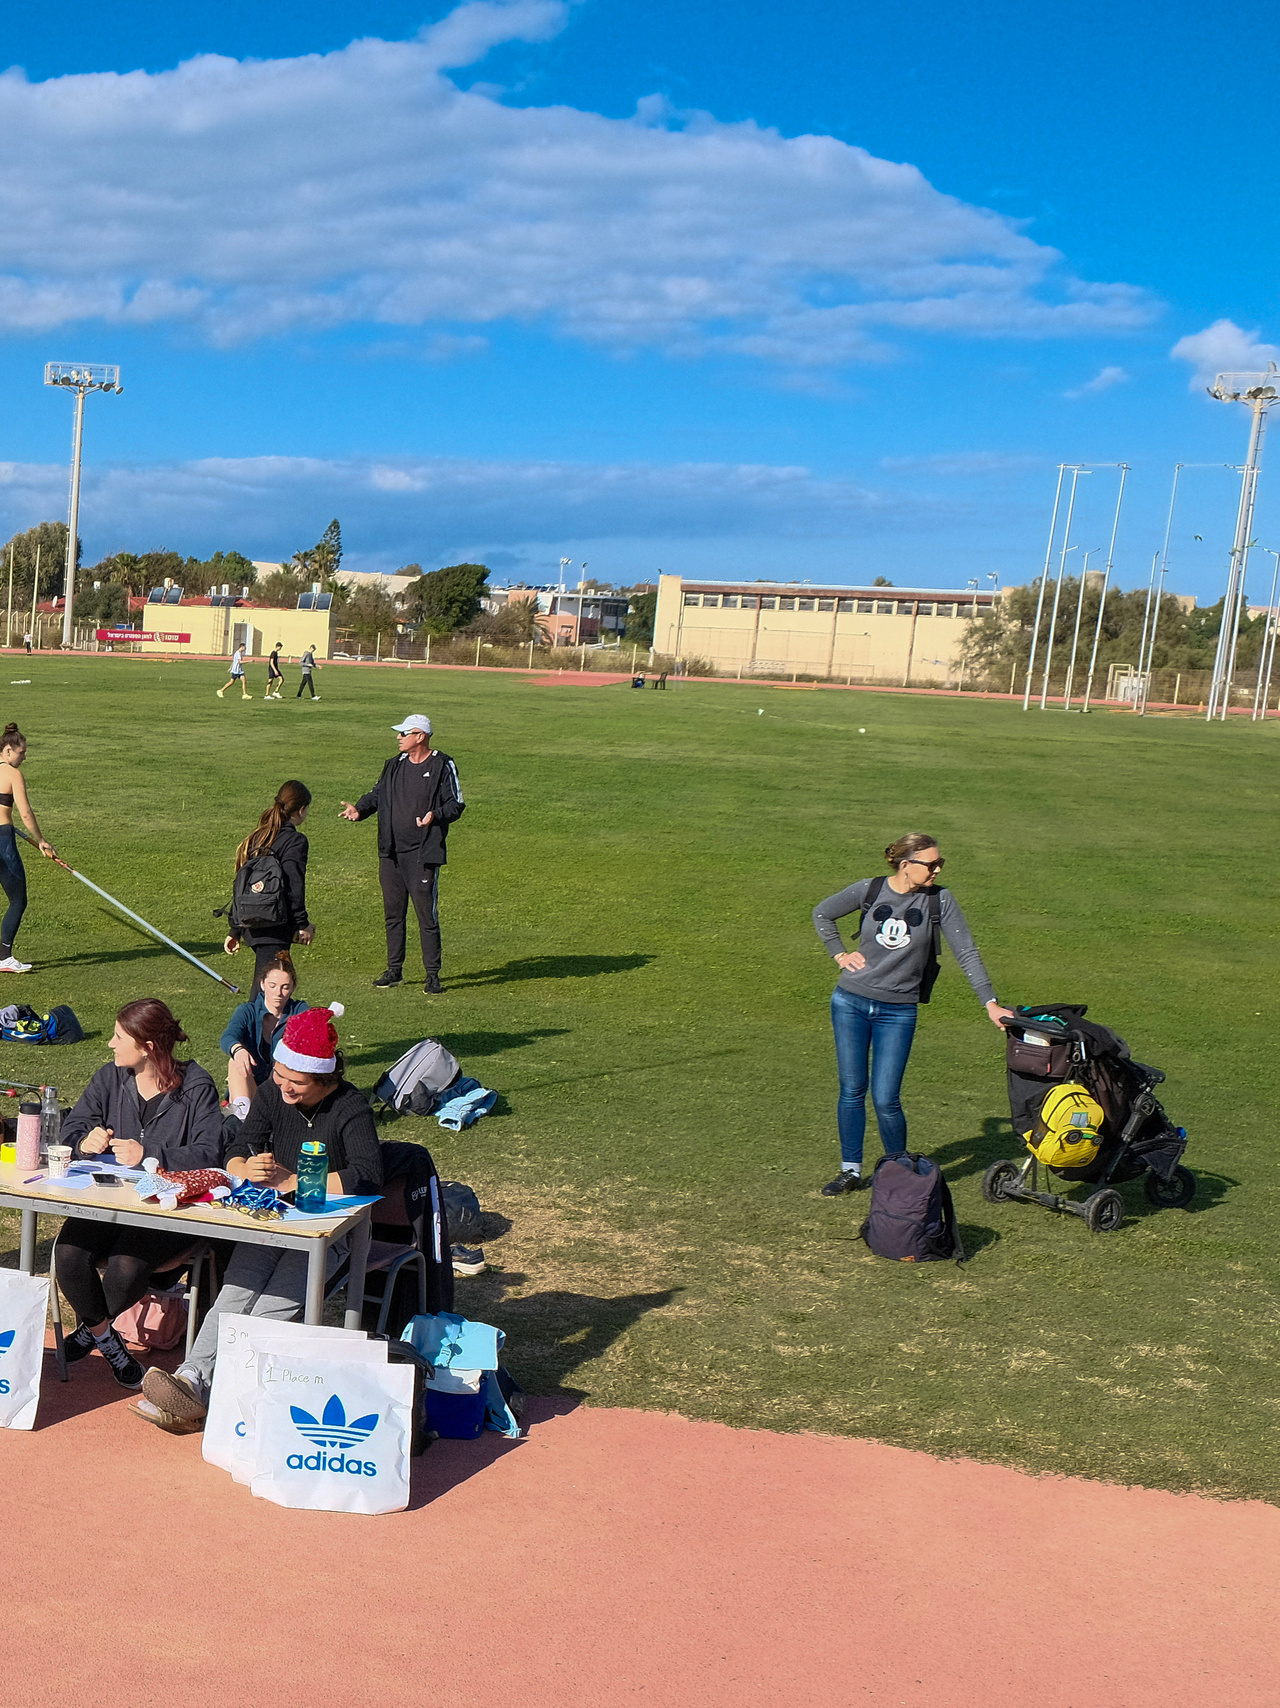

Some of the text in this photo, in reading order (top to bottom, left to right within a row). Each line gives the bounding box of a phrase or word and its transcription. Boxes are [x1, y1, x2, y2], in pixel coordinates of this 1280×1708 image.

[244, 1349, 255, 1369] 2
[264, 1366, 278, 1383] 1
[282, 1368, 310, 1383] Place
[286, 1451, 377, 1477] adidas
